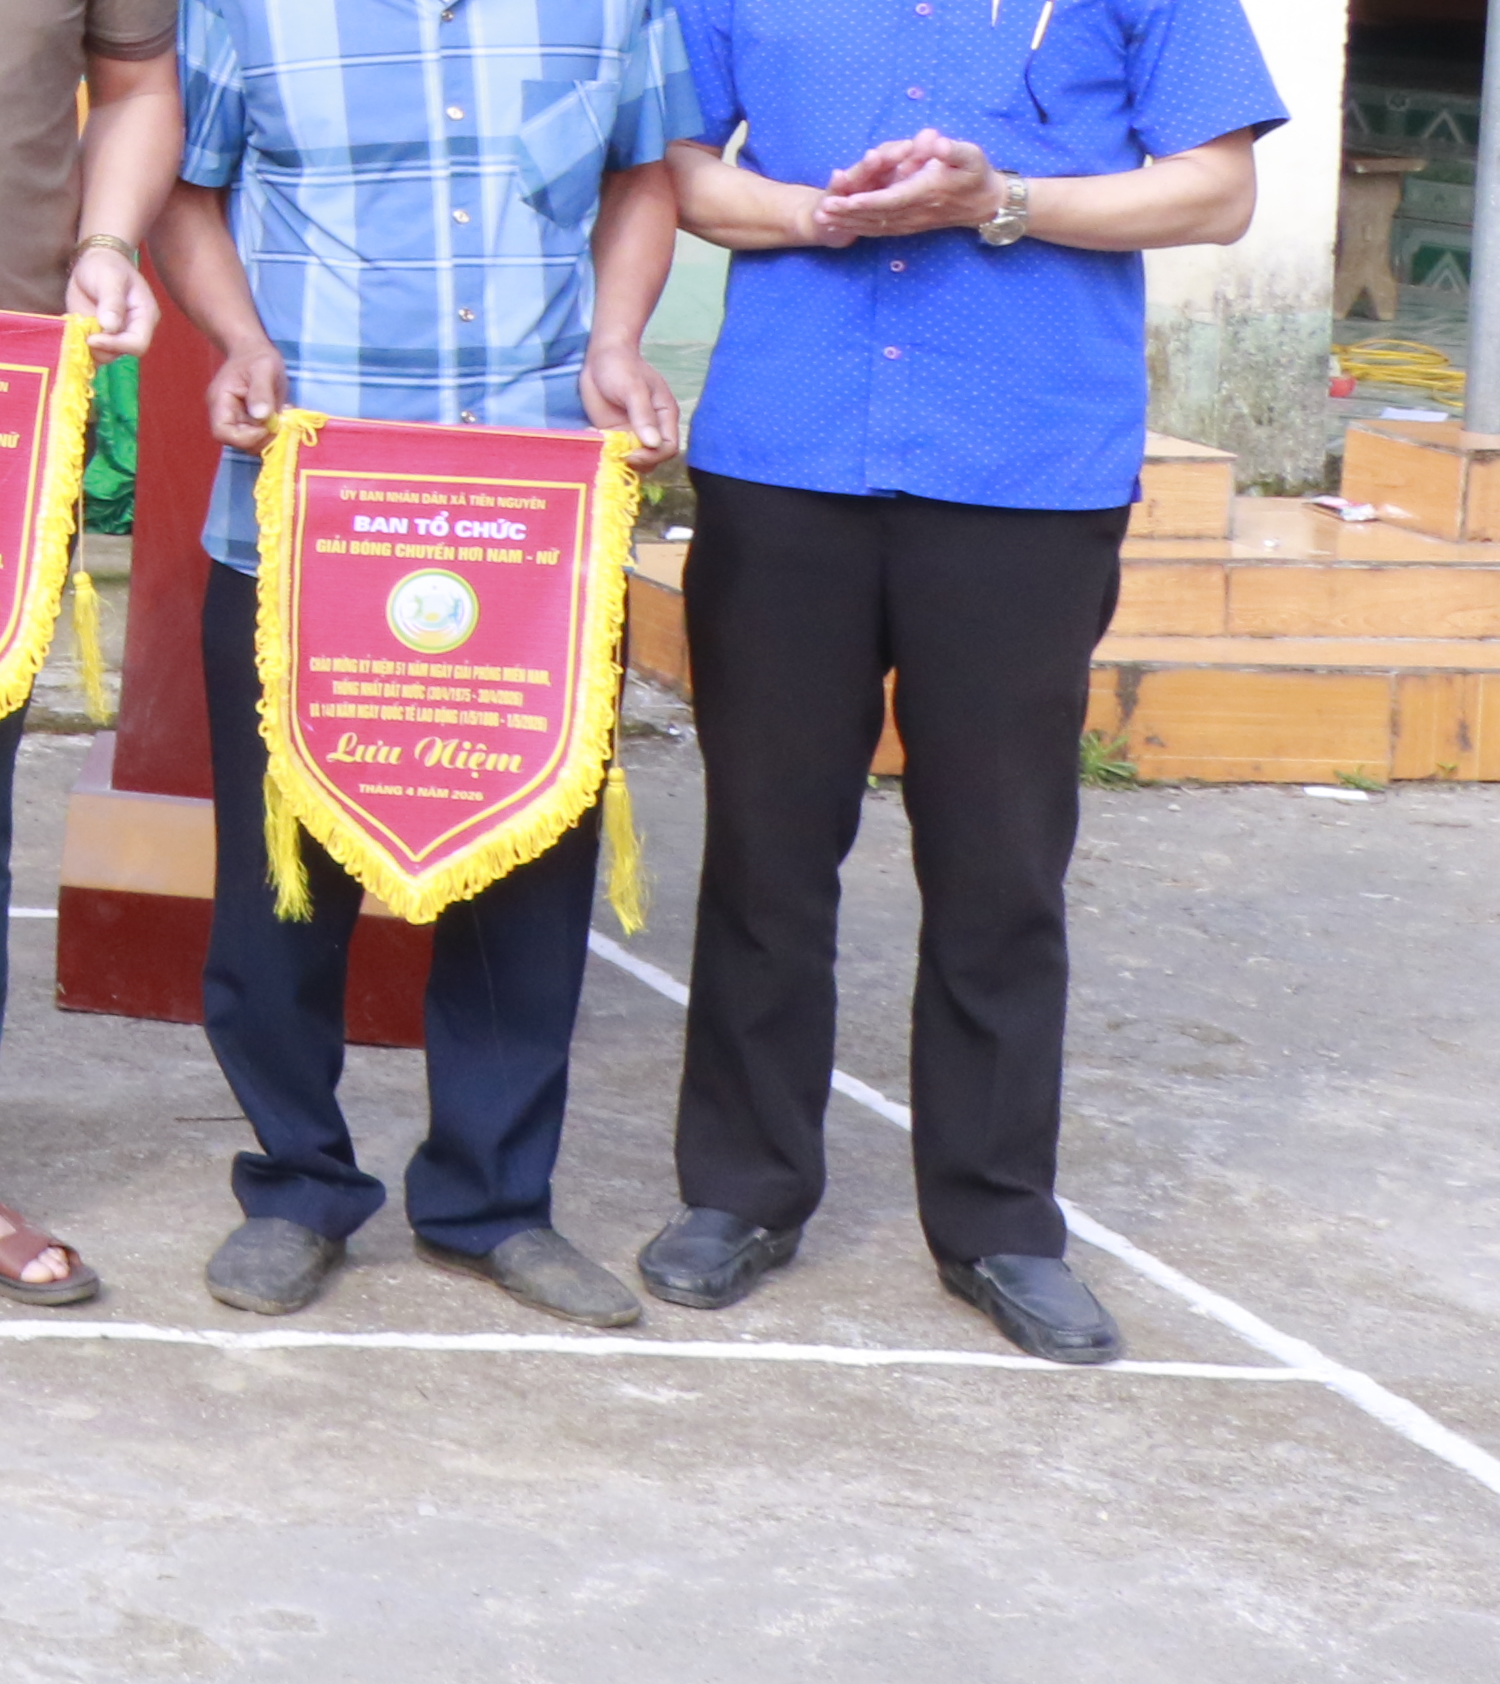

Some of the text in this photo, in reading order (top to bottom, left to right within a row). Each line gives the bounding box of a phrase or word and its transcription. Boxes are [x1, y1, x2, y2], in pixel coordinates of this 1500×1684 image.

[354, 511, 527, 540] BAN TỔ CHỨC
[326, 732, 522, 778] Lưu Niệm
